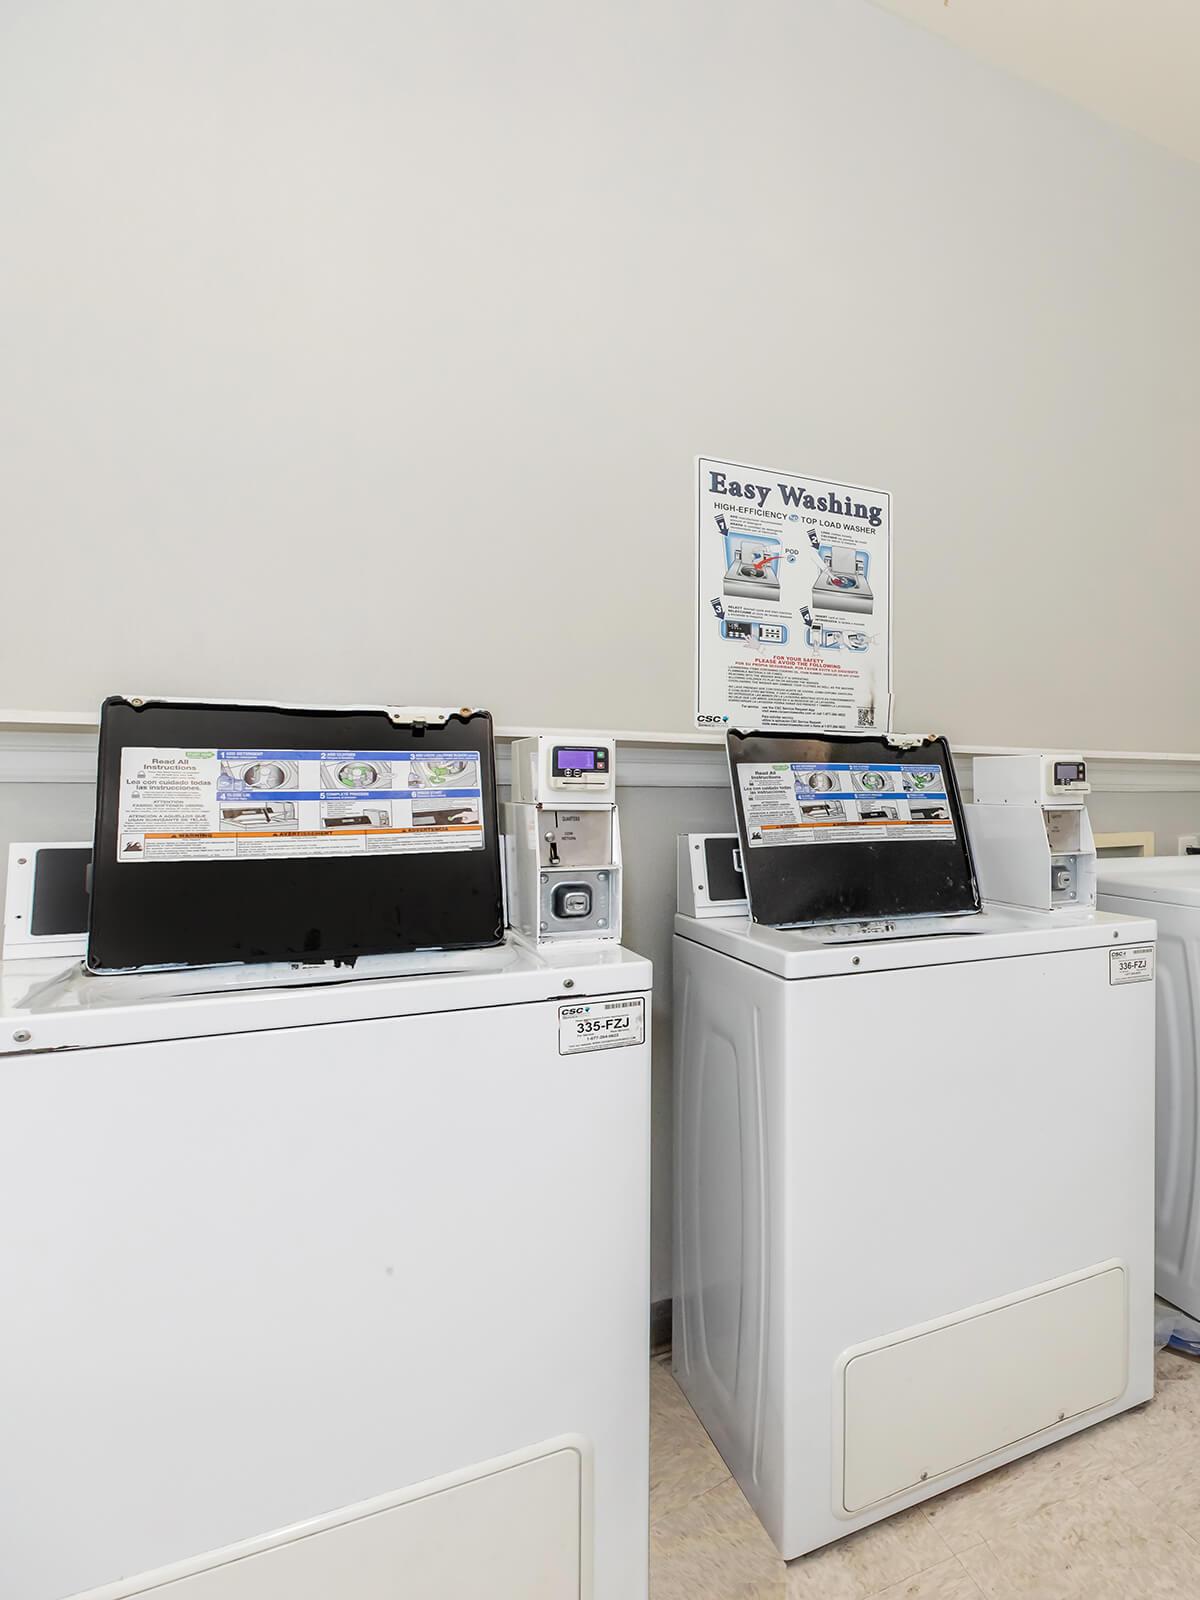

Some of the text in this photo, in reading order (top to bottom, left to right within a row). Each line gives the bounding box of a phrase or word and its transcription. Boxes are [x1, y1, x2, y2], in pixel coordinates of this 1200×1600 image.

[708, 470, 772, 508] Easy
[777, 483, 882, 527] Washing
[714, 502, 876, 534] HIGH-EFFICIENCY TOP LOAD WASHER
[811, 536, 817, 544] 2
[715, 604, 721, 613] 3
[697, 714, 721, 723] CSC
[1120, 960, 1146, 970] 336-FZJ
[561, 1007, 584, 1016] CSC
[577, 1017, 630, 1034] 335-FZJ
